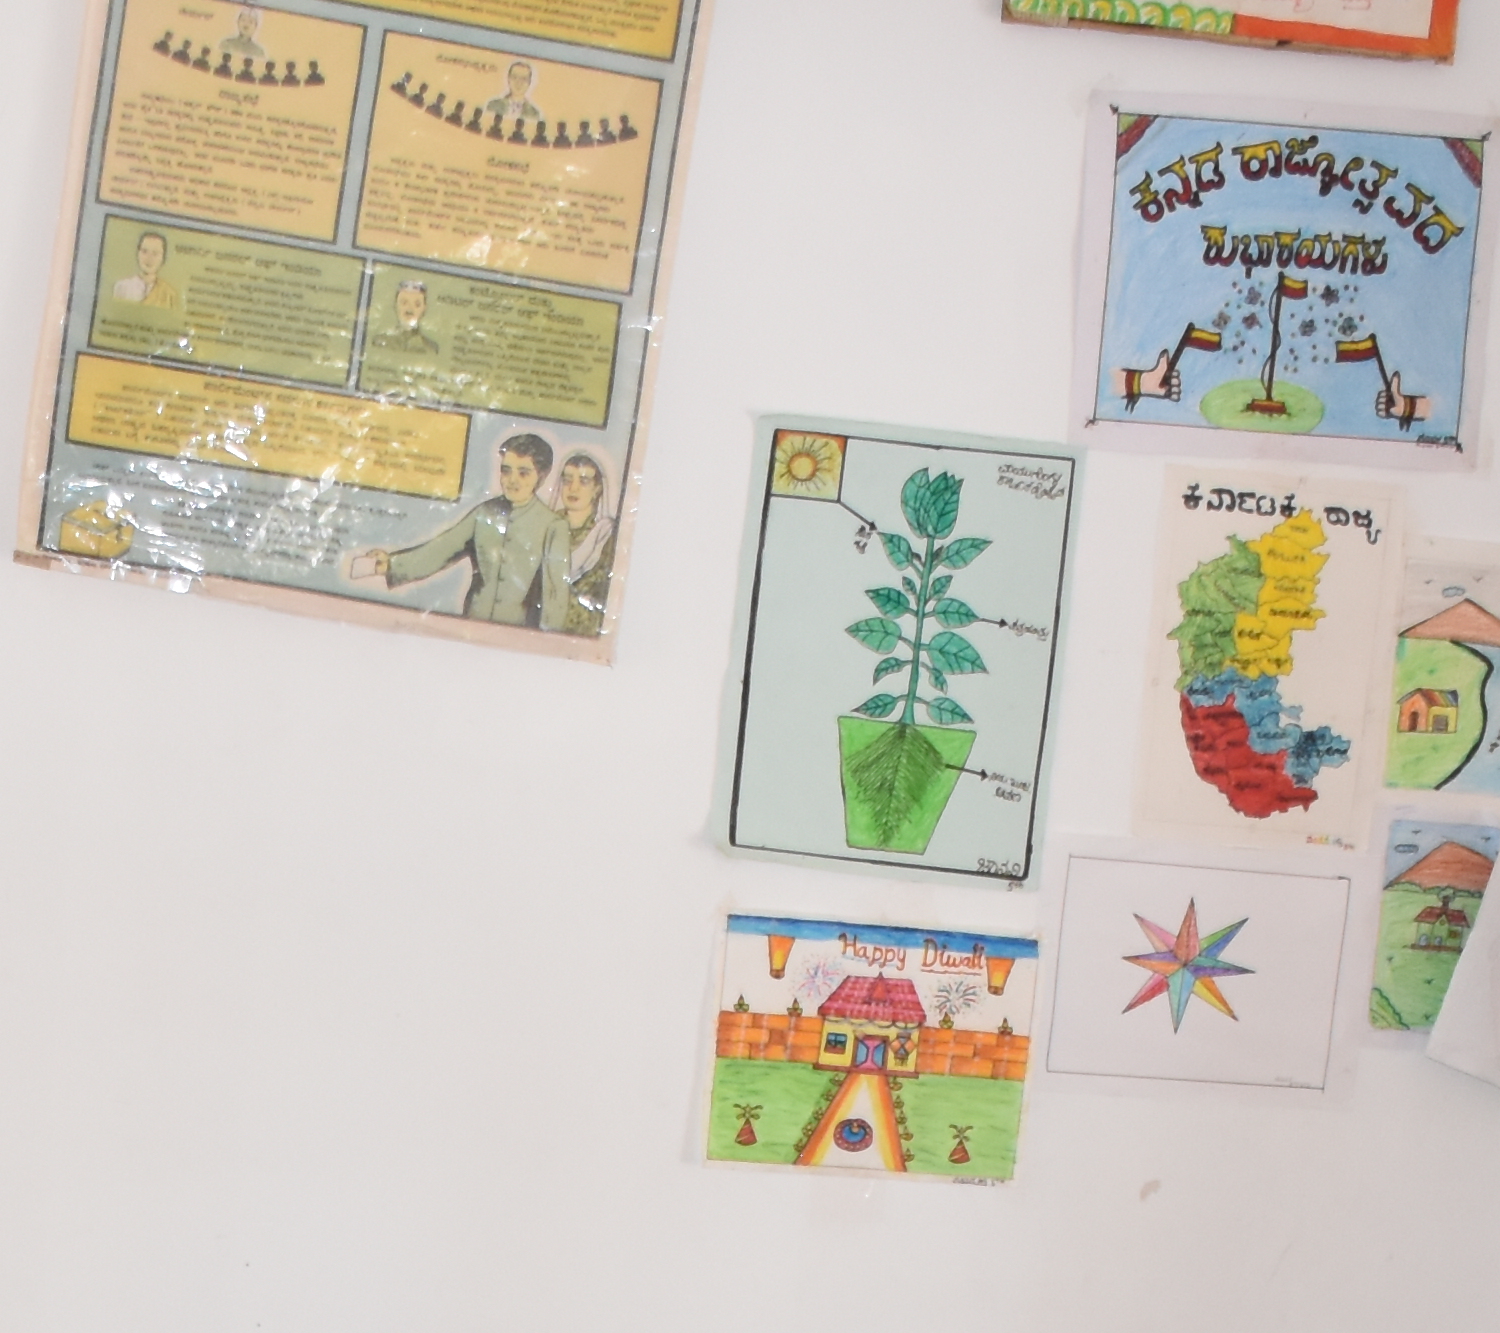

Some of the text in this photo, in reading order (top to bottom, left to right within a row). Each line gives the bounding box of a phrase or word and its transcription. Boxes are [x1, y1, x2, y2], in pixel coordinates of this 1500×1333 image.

[1129, 142, 1227, 223] ಕನ್ನಡ
[1181, 483, 1382, 546] ಕರ್ನಾಟಕ ರಾಜ್ಯ
[837, 931, 908, 972] Happy
